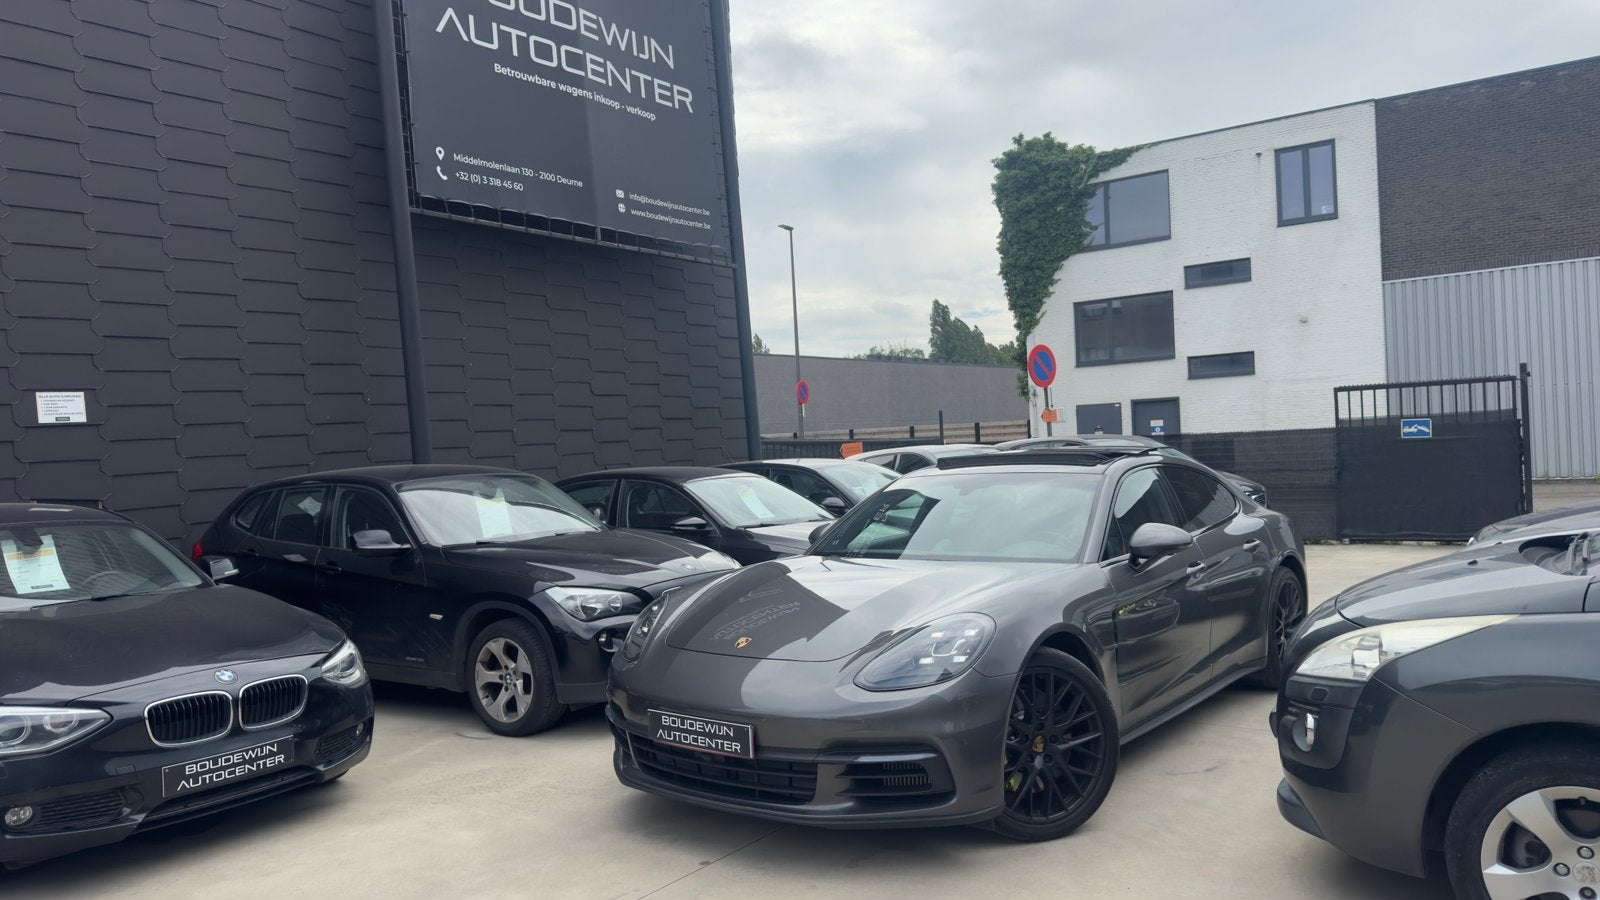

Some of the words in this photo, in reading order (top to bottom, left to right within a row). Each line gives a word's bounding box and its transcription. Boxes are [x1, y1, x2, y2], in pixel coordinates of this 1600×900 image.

[488, 0, 675, 69] UDEWIJN
[435, 7, 694, 113] AUTOCENTER
[494, 62, 557, 89] Betrouwbare
[558, 82, 593, 99] wagens
[593, 91, 620, 110] inkoop
[626, 104, 656, 121] verkoop
[453, 153, 521, 175] Middelmolenlaan
[521, 167, 534, 177] 130
[539, 171, 556, 182] 2100
[556, 175, 584, 188] Deurne
[455, 171, 469, 181] +32
[470, 173, 481, 185] (0)
[482, 175, 488, 184] 3
[488, 177, 501, 187] 318
[502, 180, 512, 189] 45
[513, 182, 524, 191] 60
[628, 191, 711, 216] info@boudewijnautocenter.be
[630, 208, 711, 230] www.boudewijnautocenter.be
[656, 728, 741, 753] AUTOCENTER
[661, 715, 734, 737] BOUDEWIJN
[176, 754, 285, 792] AUTOCENTER
[185, 743, 278, 775] BOUDEWIJN
